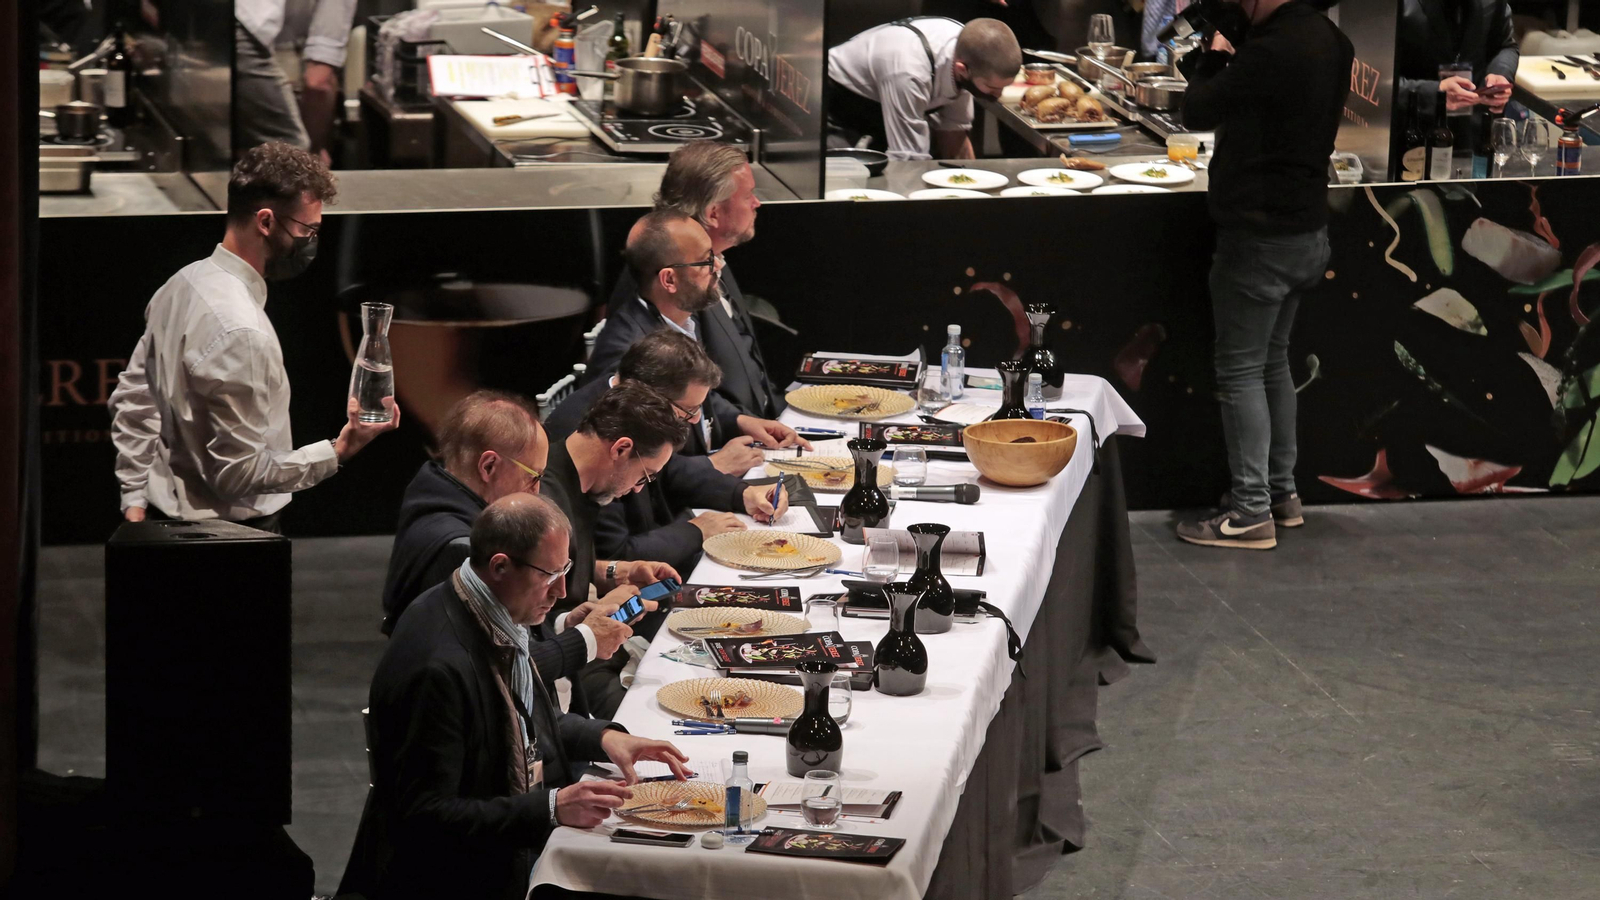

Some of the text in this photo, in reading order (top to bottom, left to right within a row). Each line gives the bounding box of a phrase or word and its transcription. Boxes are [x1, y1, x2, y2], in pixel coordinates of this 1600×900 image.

[735, 26, 770, 81] COPA
[775, 54, 811, 115] JEREZ
[1350, 57, 1380, 107] REZ
[38, 358, 129, 406] RE
